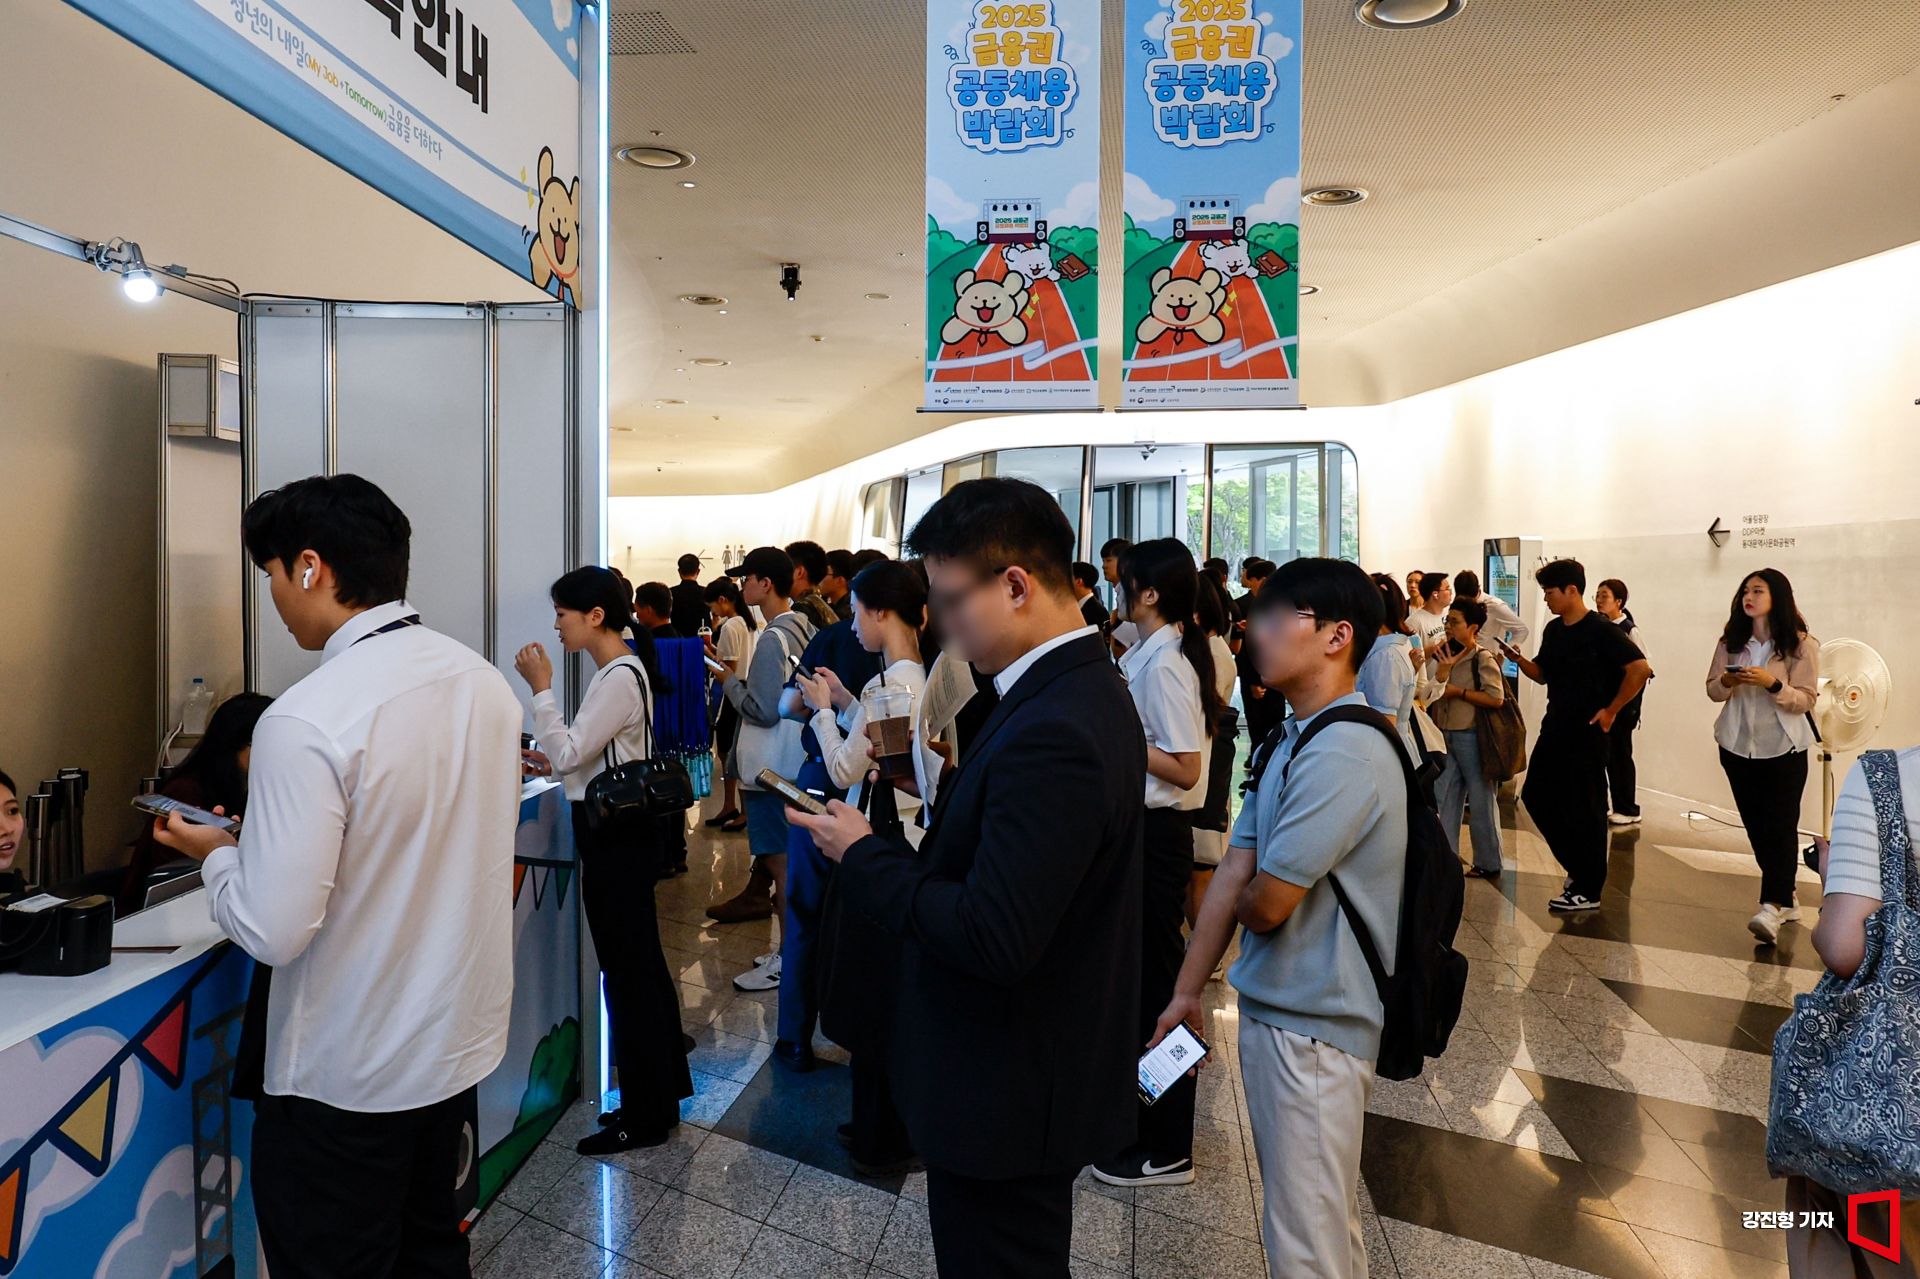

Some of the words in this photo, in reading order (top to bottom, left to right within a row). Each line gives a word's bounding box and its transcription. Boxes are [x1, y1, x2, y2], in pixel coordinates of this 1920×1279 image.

[980, 4, 1046, 28] 2025
[1179, 0, 1246, 22] 2025
[973, 31, 1055, 67] 금융권
[1171, 25, 1254, 61] 금융권
[953, 67, 1070, 107] 공동채용
[1150, 61, 1270, 102] 공동채용
[963, 106, 1055, 144] 박람회
[1160, 100, 1255, 140] 박람회
[413, 126, 443, 160] 더하다
